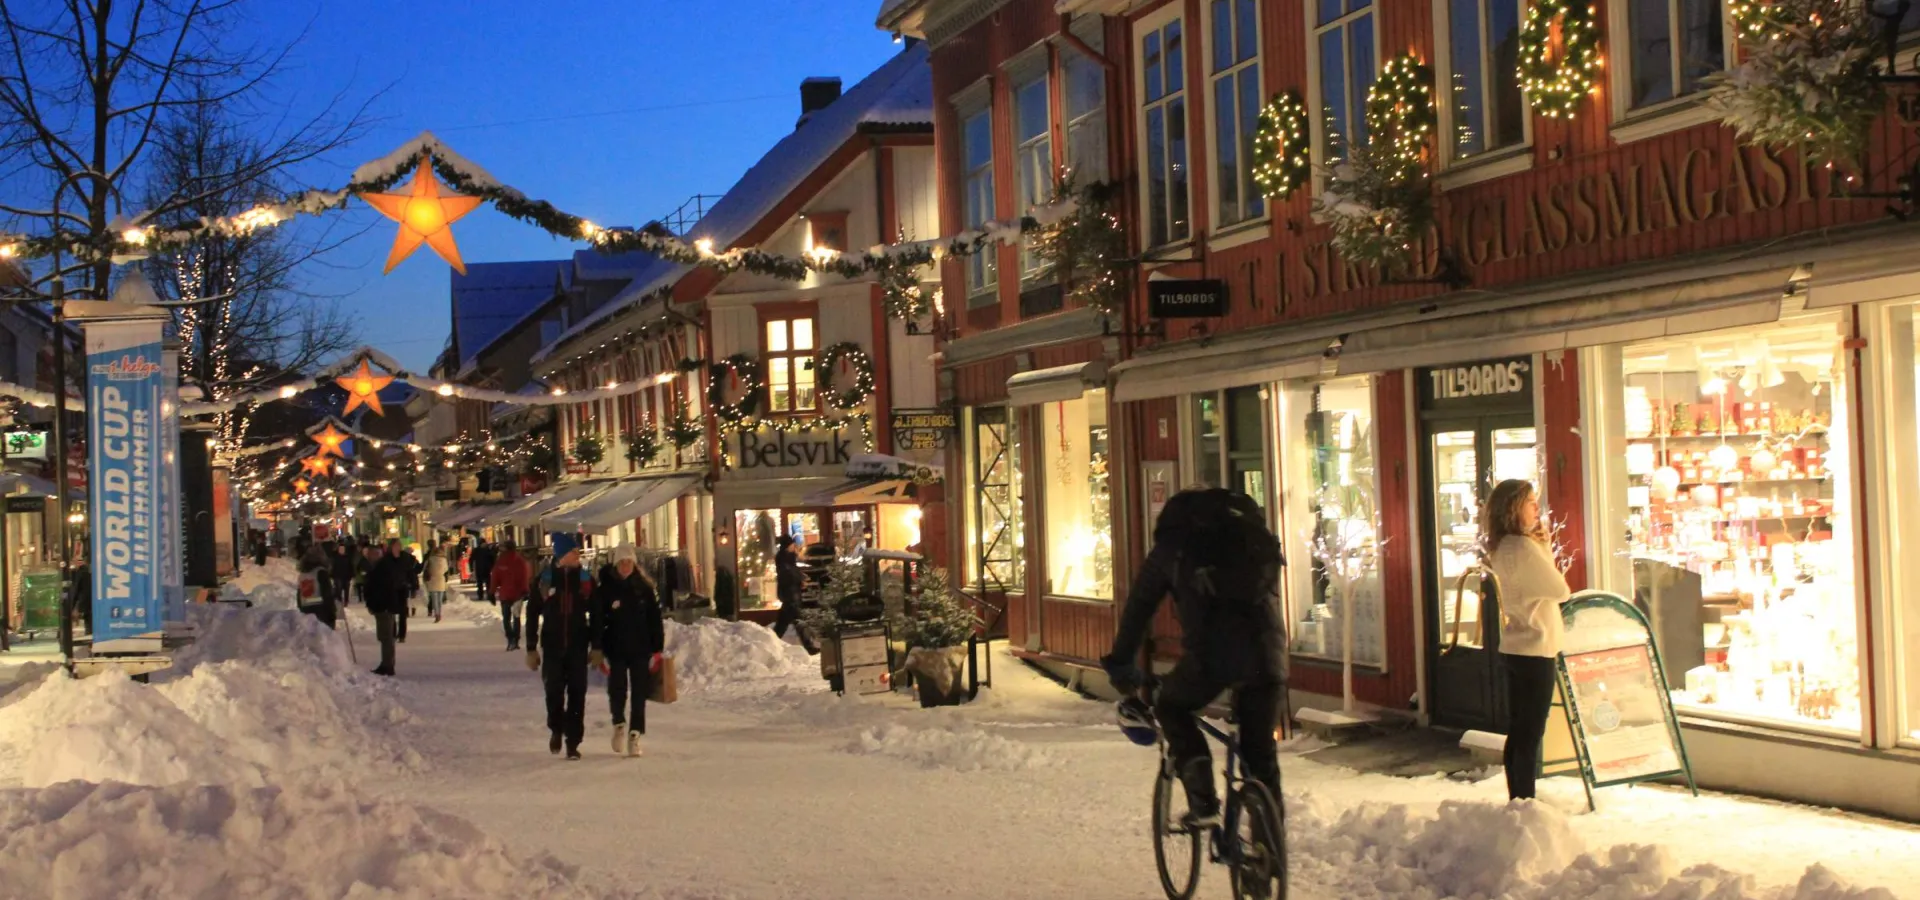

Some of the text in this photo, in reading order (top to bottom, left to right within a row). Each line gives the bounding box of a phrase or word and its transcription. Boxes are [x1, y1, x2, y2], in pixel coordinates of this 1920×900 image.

[1461, 138, 1842, 267] GLASSMAGASI
[1159, 293, 1215, 304] TILBORDS
[1430, 361, 1524, 399] TILBORDS
[103, 386, 129, 459] CUP
[739, 428, 850, 469] Belsvik
[132, 410, 149, 575] LILLEHAMMER
[105, 468, 131, 598] WORLD
